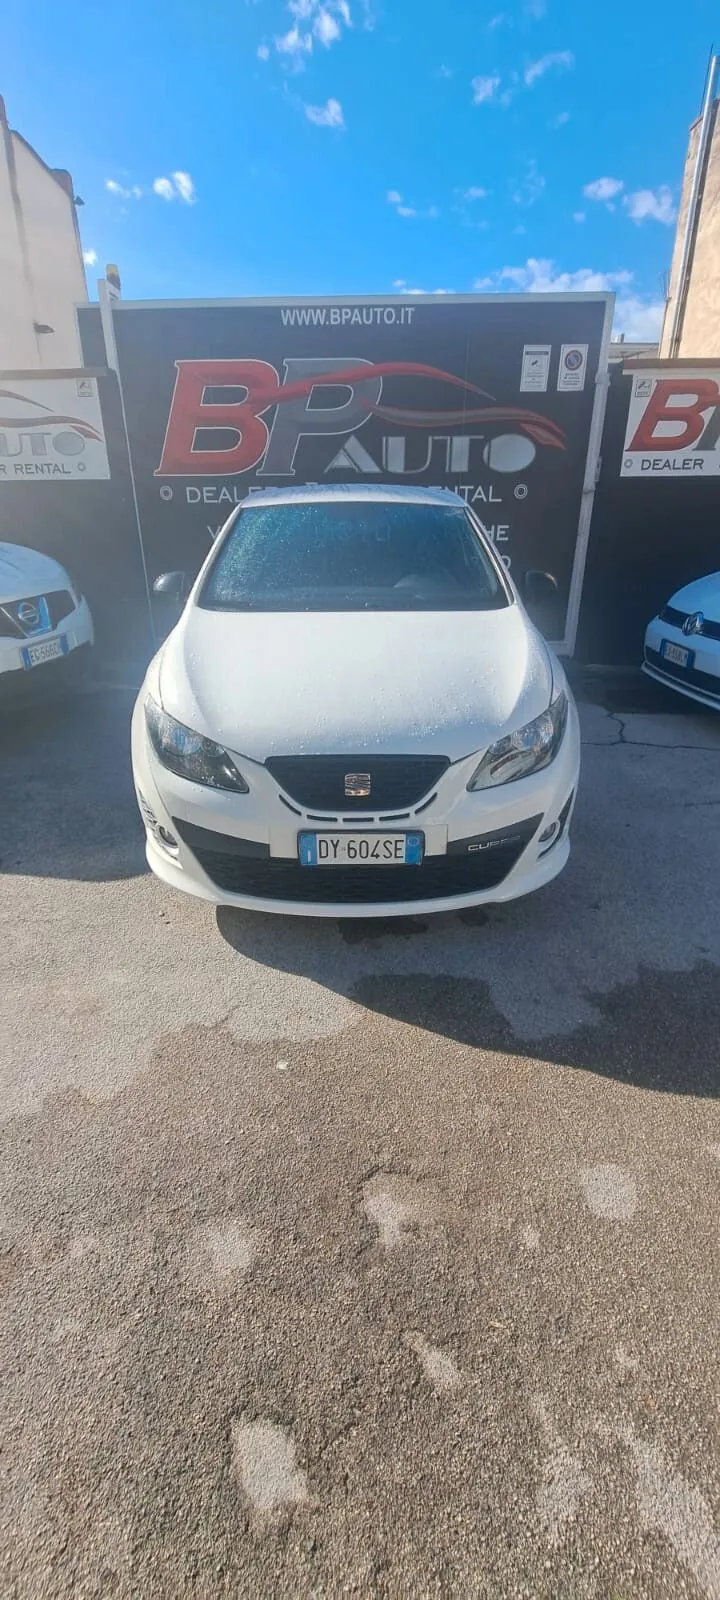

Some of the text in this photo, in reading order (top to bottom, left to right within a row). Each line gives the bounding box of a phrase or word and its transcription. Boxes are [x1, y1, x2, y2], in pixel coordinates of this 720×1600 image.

[280, 307, 416, 326] WWW.BPAUTO.IT
[153, 358, 537, 477] BP AUTO
[13, 463, 72, 475] RENTAL
[640, 458, 705, 471] DEALER
[186, 486, 278, 503] DEAL
